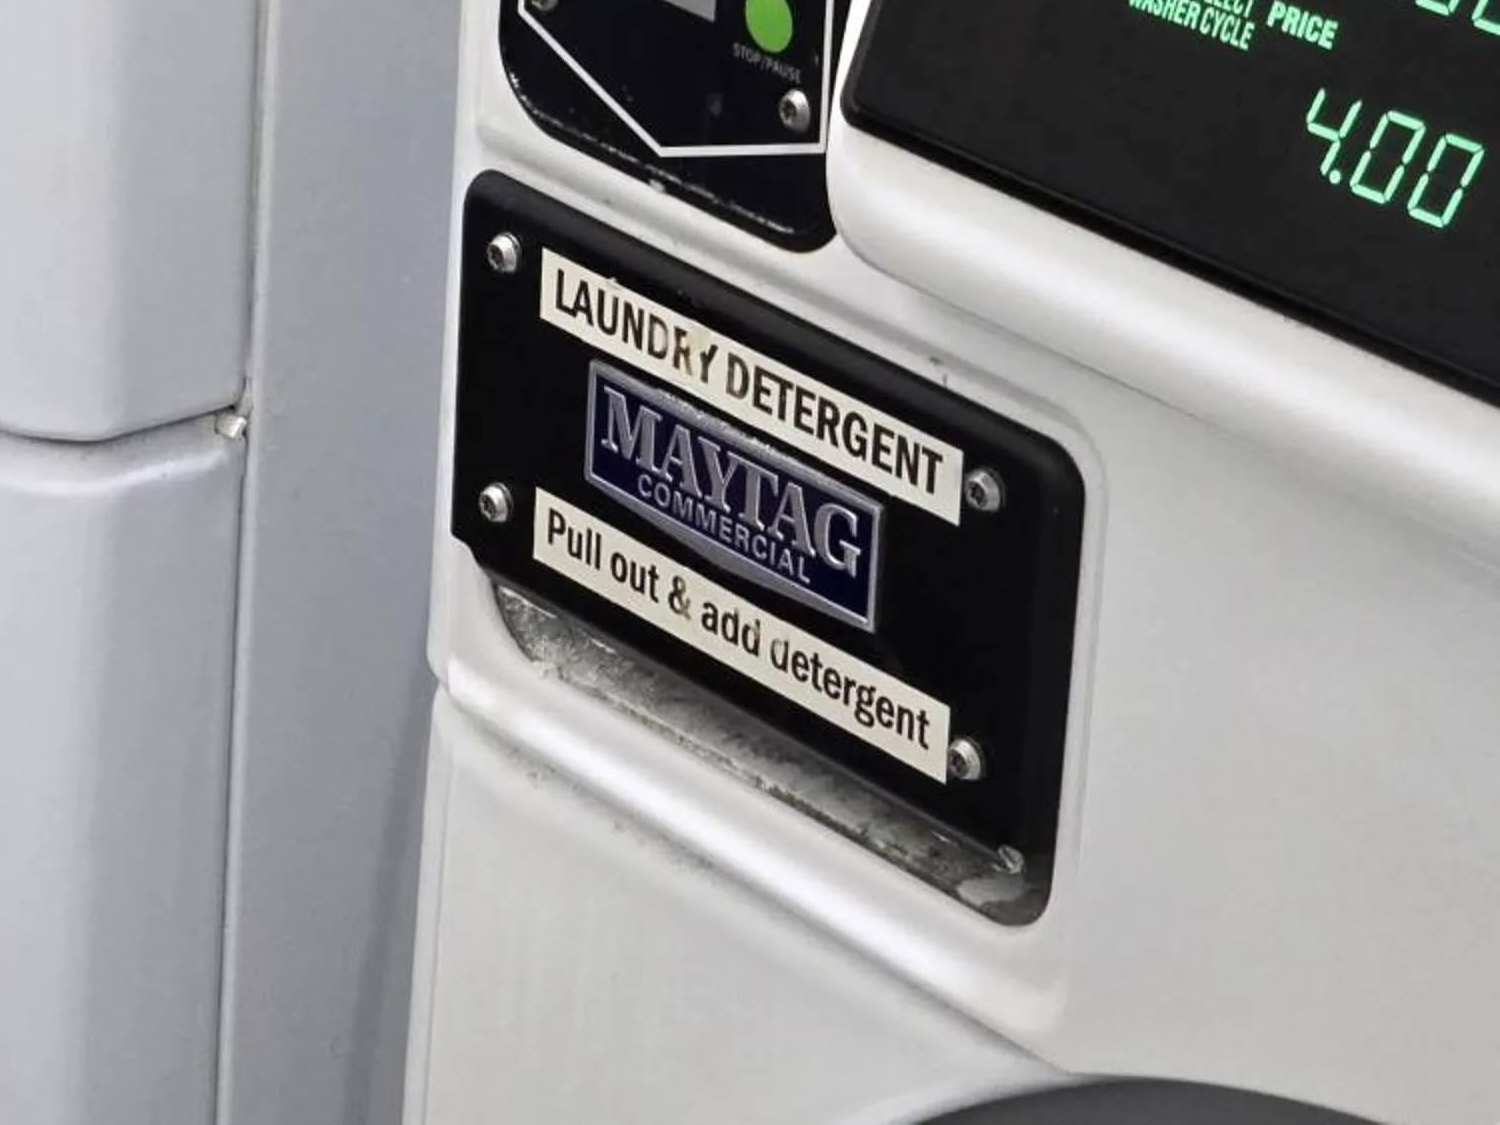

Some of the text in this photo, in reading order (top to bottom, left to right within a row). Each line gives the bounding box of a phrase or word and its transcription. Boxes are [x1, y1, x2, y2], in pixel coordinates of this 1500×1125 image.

[732, 42, 802, 84] STOP/PAUSE
[1200, 7, 1256, 52] CYCLE
[1266, 0, 1339, 51] PRICE
[1306, 87, 1485, 229] 4.00
[555, 269, 943, 495] LAUNDRY DETERGENT
[601, 385, 863, 579] MAYTAG
[637, 474, 811, 584] COMMERCIAL
[547, 507, 930, 751] Pull out & add detergent
